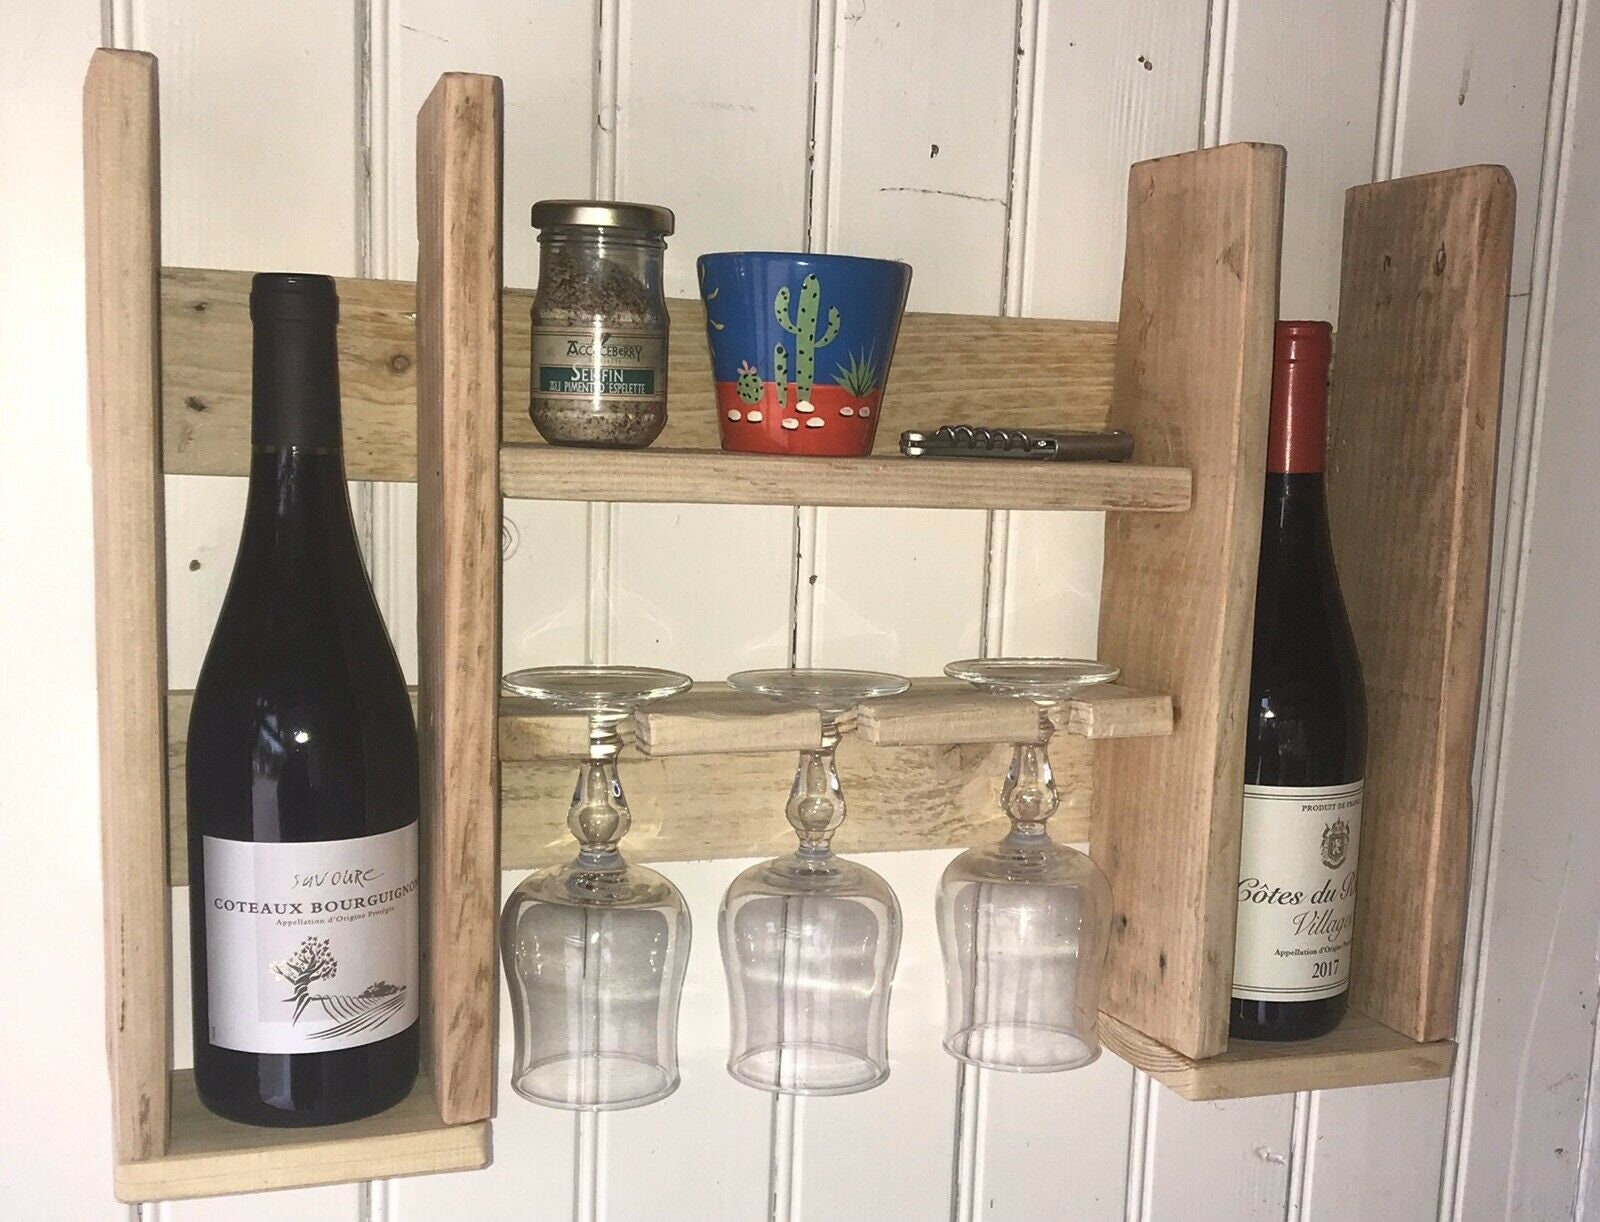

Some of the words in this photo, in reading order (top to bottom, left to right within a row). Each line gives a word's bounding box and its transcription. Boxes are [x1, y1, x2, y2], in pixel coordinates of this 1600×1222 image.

[602, 368, 624, 382] FIN
[564, 381, 597, 393] PIMENT
[1301, 803, 1336, 811] PRODUIT
[1238, 877, 1304, 905] Côtes
[1310, 878, 1338, 904] du
[214, 898, 303, 915] COTEAUX
[276, 918, 325, 927] Appellation
[328, 913, 366, 924] d'Origine
[1274, 947, 1317, 958] Appellation
[1312, 959, 1339, 979] 2017
